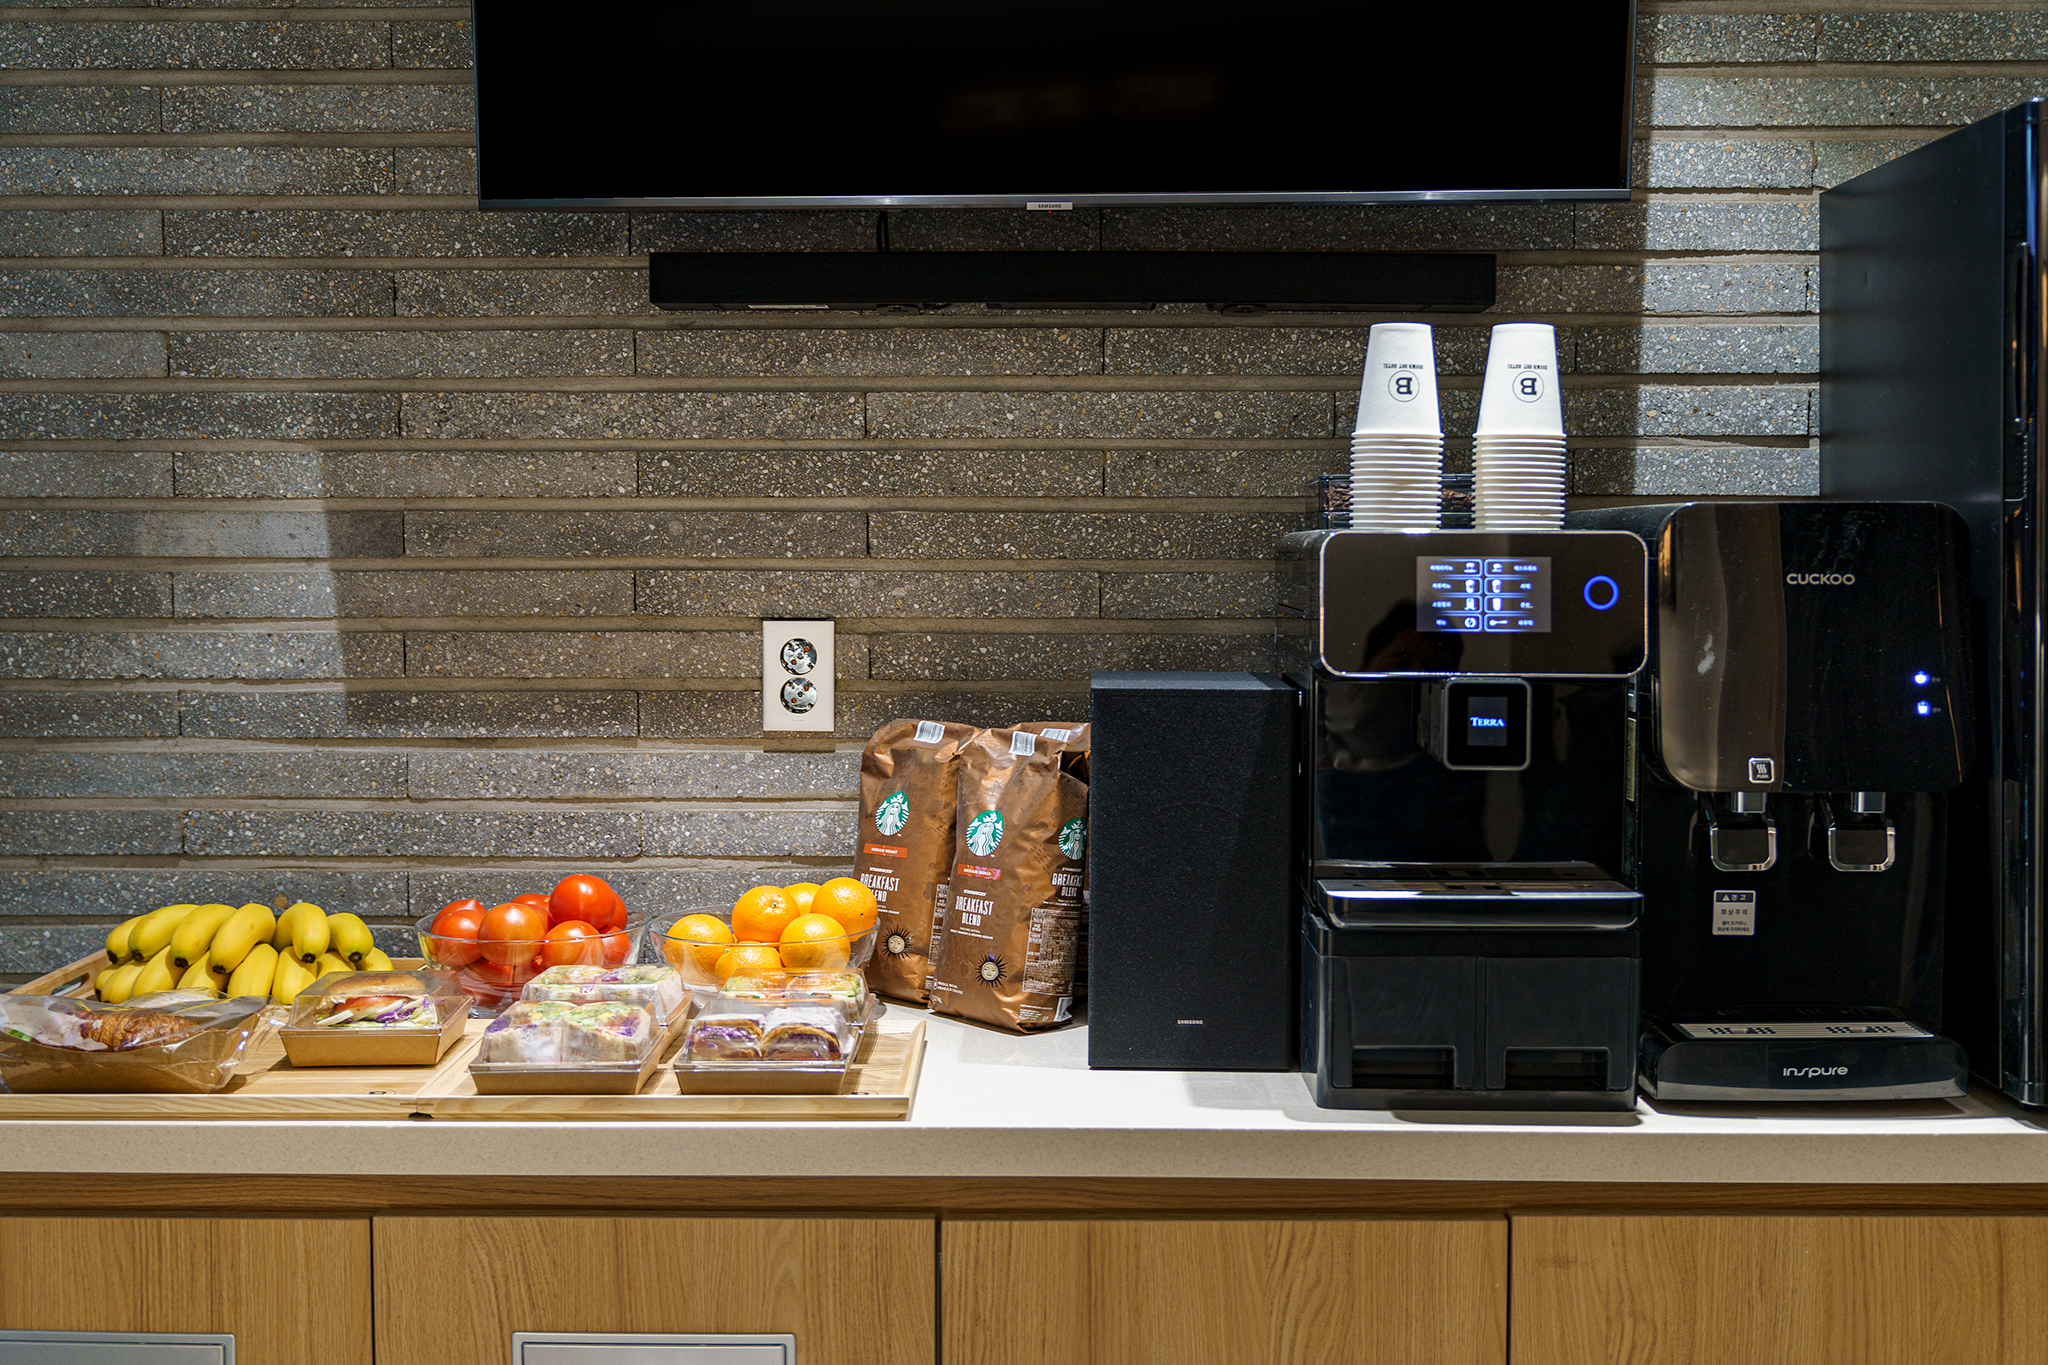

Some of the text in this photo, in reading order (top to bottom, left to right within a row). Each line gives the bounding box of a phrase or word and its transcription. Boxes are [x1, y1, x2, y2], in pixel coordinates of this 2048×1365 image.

[1395, 377, 1412, 394] B
[1520, 377, 1537, 395] B
[1786, 573, 1855, 585] CUCKOO
[869, 866, 893, 874] STARBUCKS
[860, 873, 900, 891] BREAKFAST
[871, 888, 888, 902] END
[963, 889, 987, 897] STARBUCKS
[955, 896, 994, 916] BREAKFAST
[962, 912, 981, 927] BLEND
